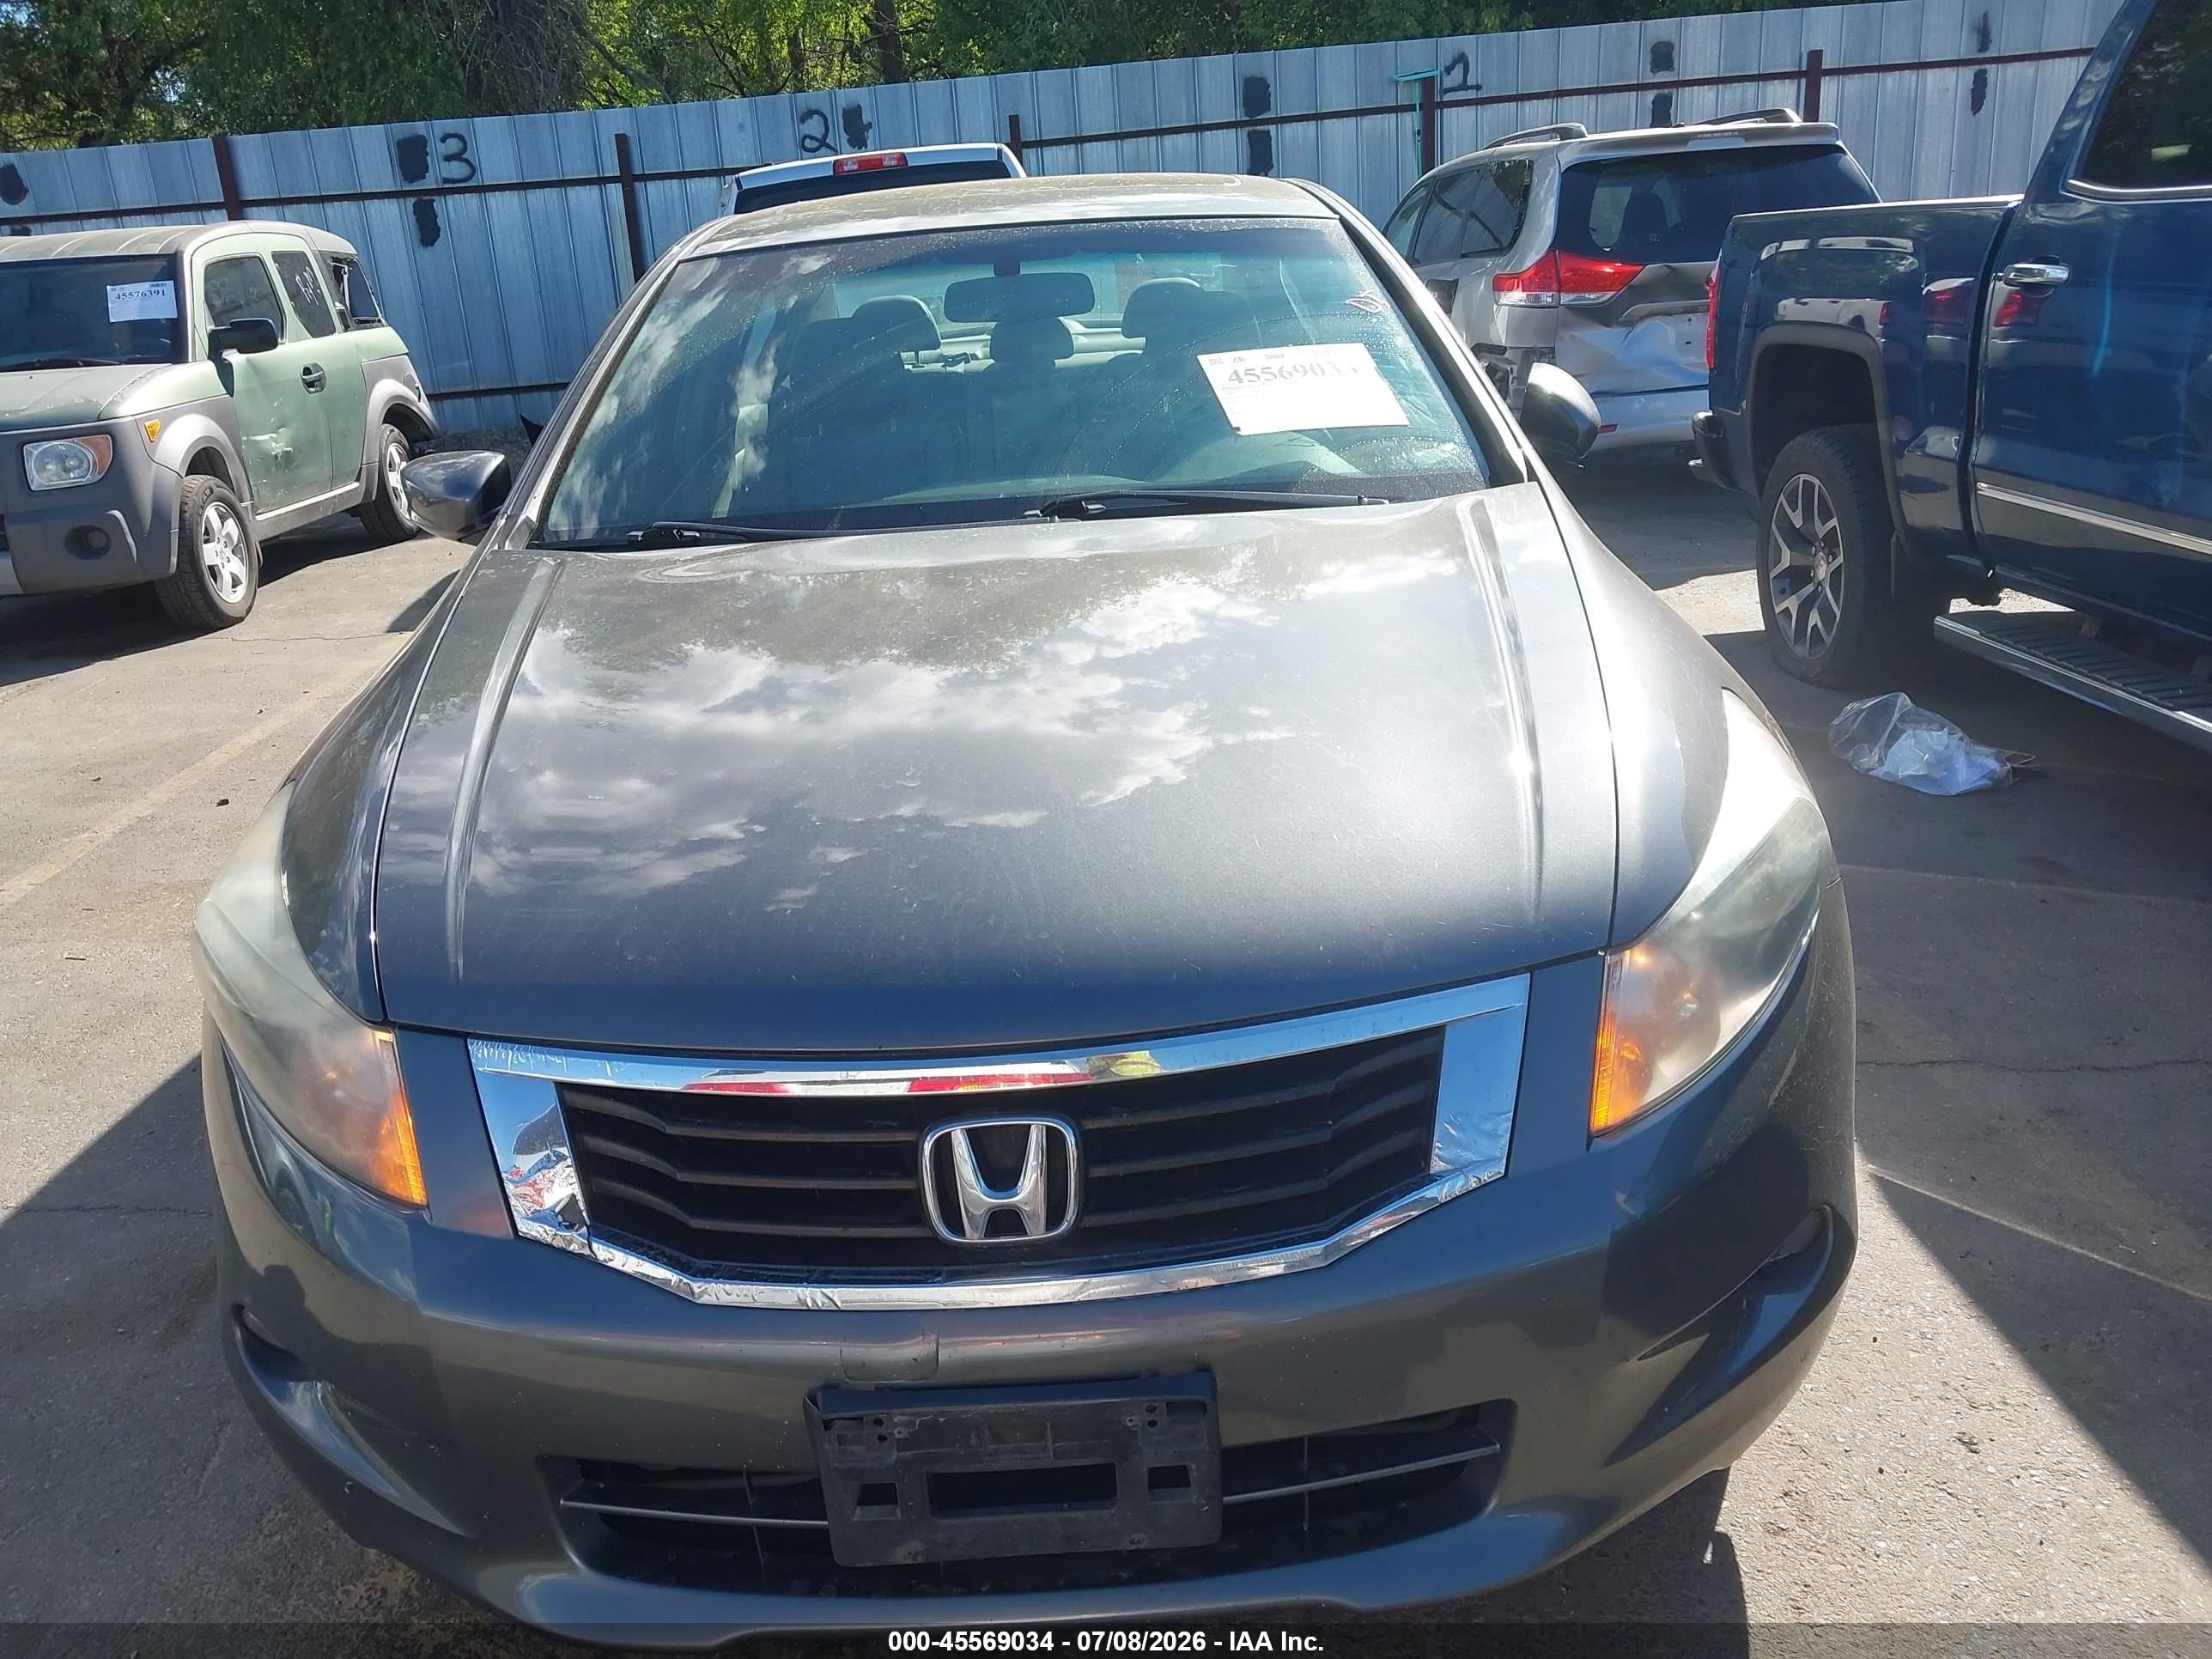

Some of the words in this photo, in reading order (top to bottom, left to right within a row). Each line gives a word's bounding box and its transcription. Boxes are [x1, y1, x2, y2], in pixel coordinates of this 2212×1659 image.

[799, 109, 839, 153] 2
[440, 132, 477, 184] 3
[114, 289, 167, 301] 45576391
